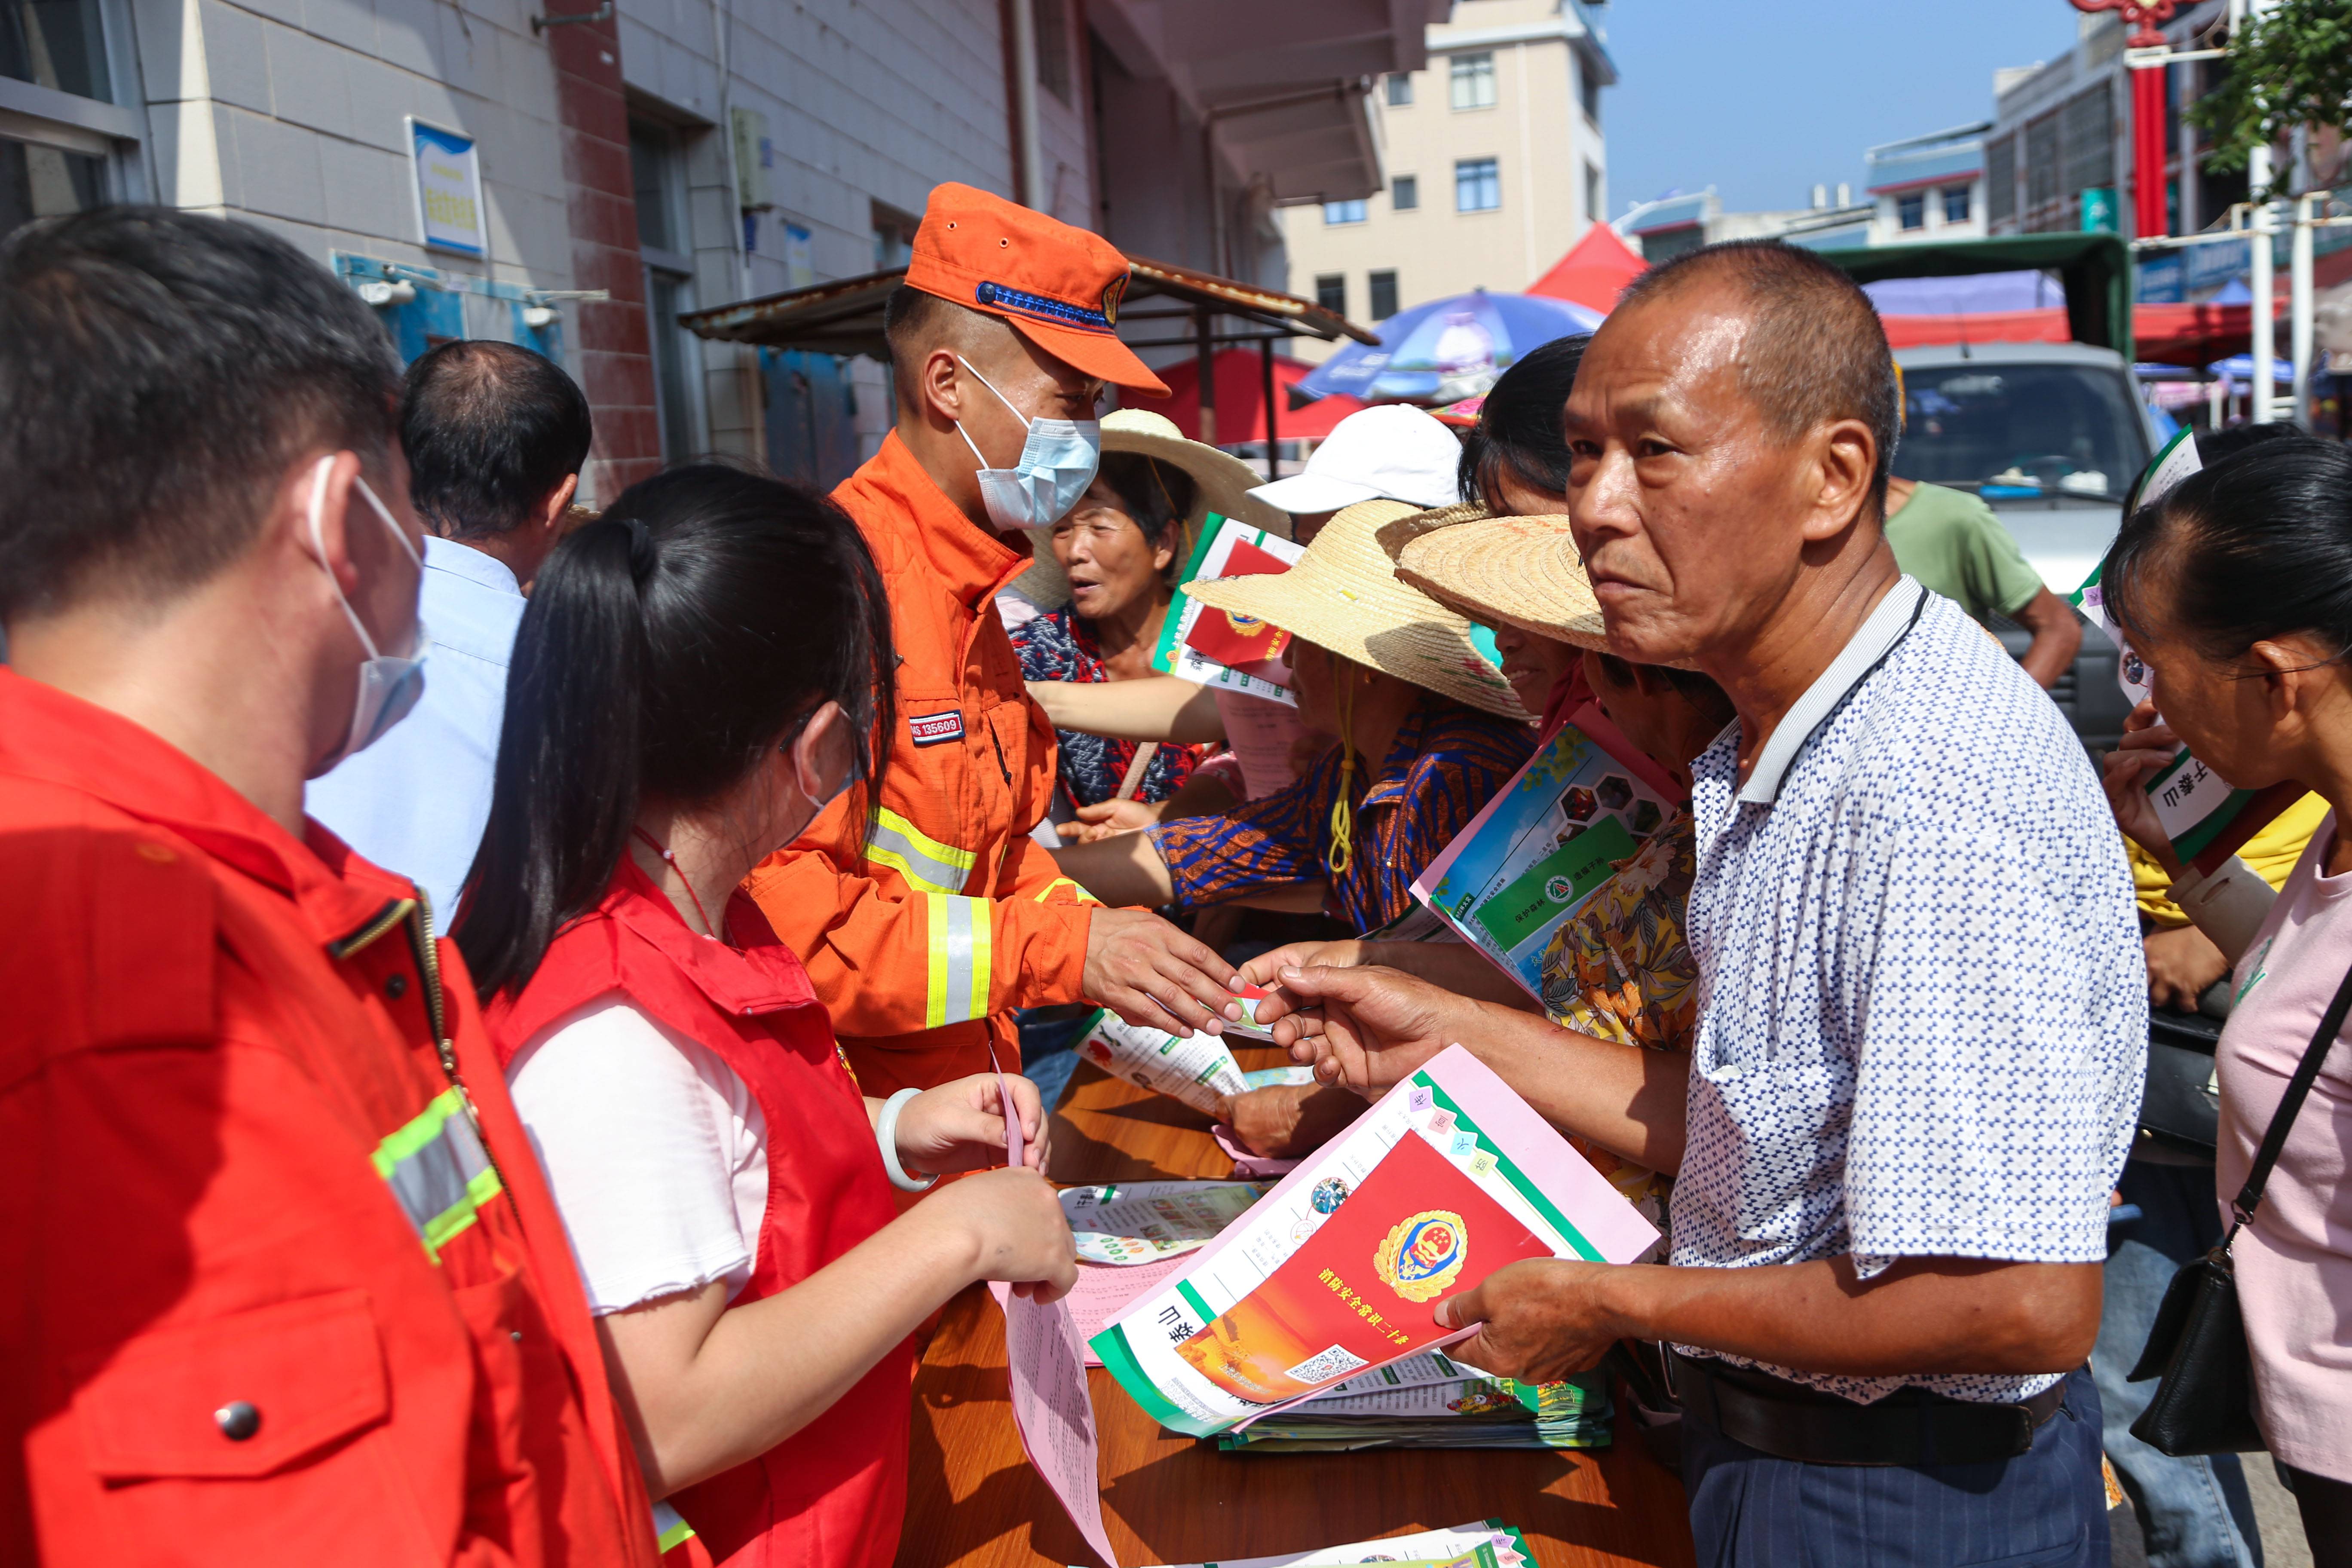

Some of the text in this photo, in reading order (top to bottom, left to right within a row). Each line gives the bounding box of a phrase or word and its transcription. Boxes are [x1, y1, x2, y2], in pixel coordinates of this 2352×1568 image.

[922, 720, 956, 735] 135609
[1574, 855, 1605, 881] 造福子孙
[1516, 897, 1545, 922] 保护森林
[1318, 1268, 1409, 1344] 消防安全常识二十条
[1158, 1304, 1195, 1349] 泰山
